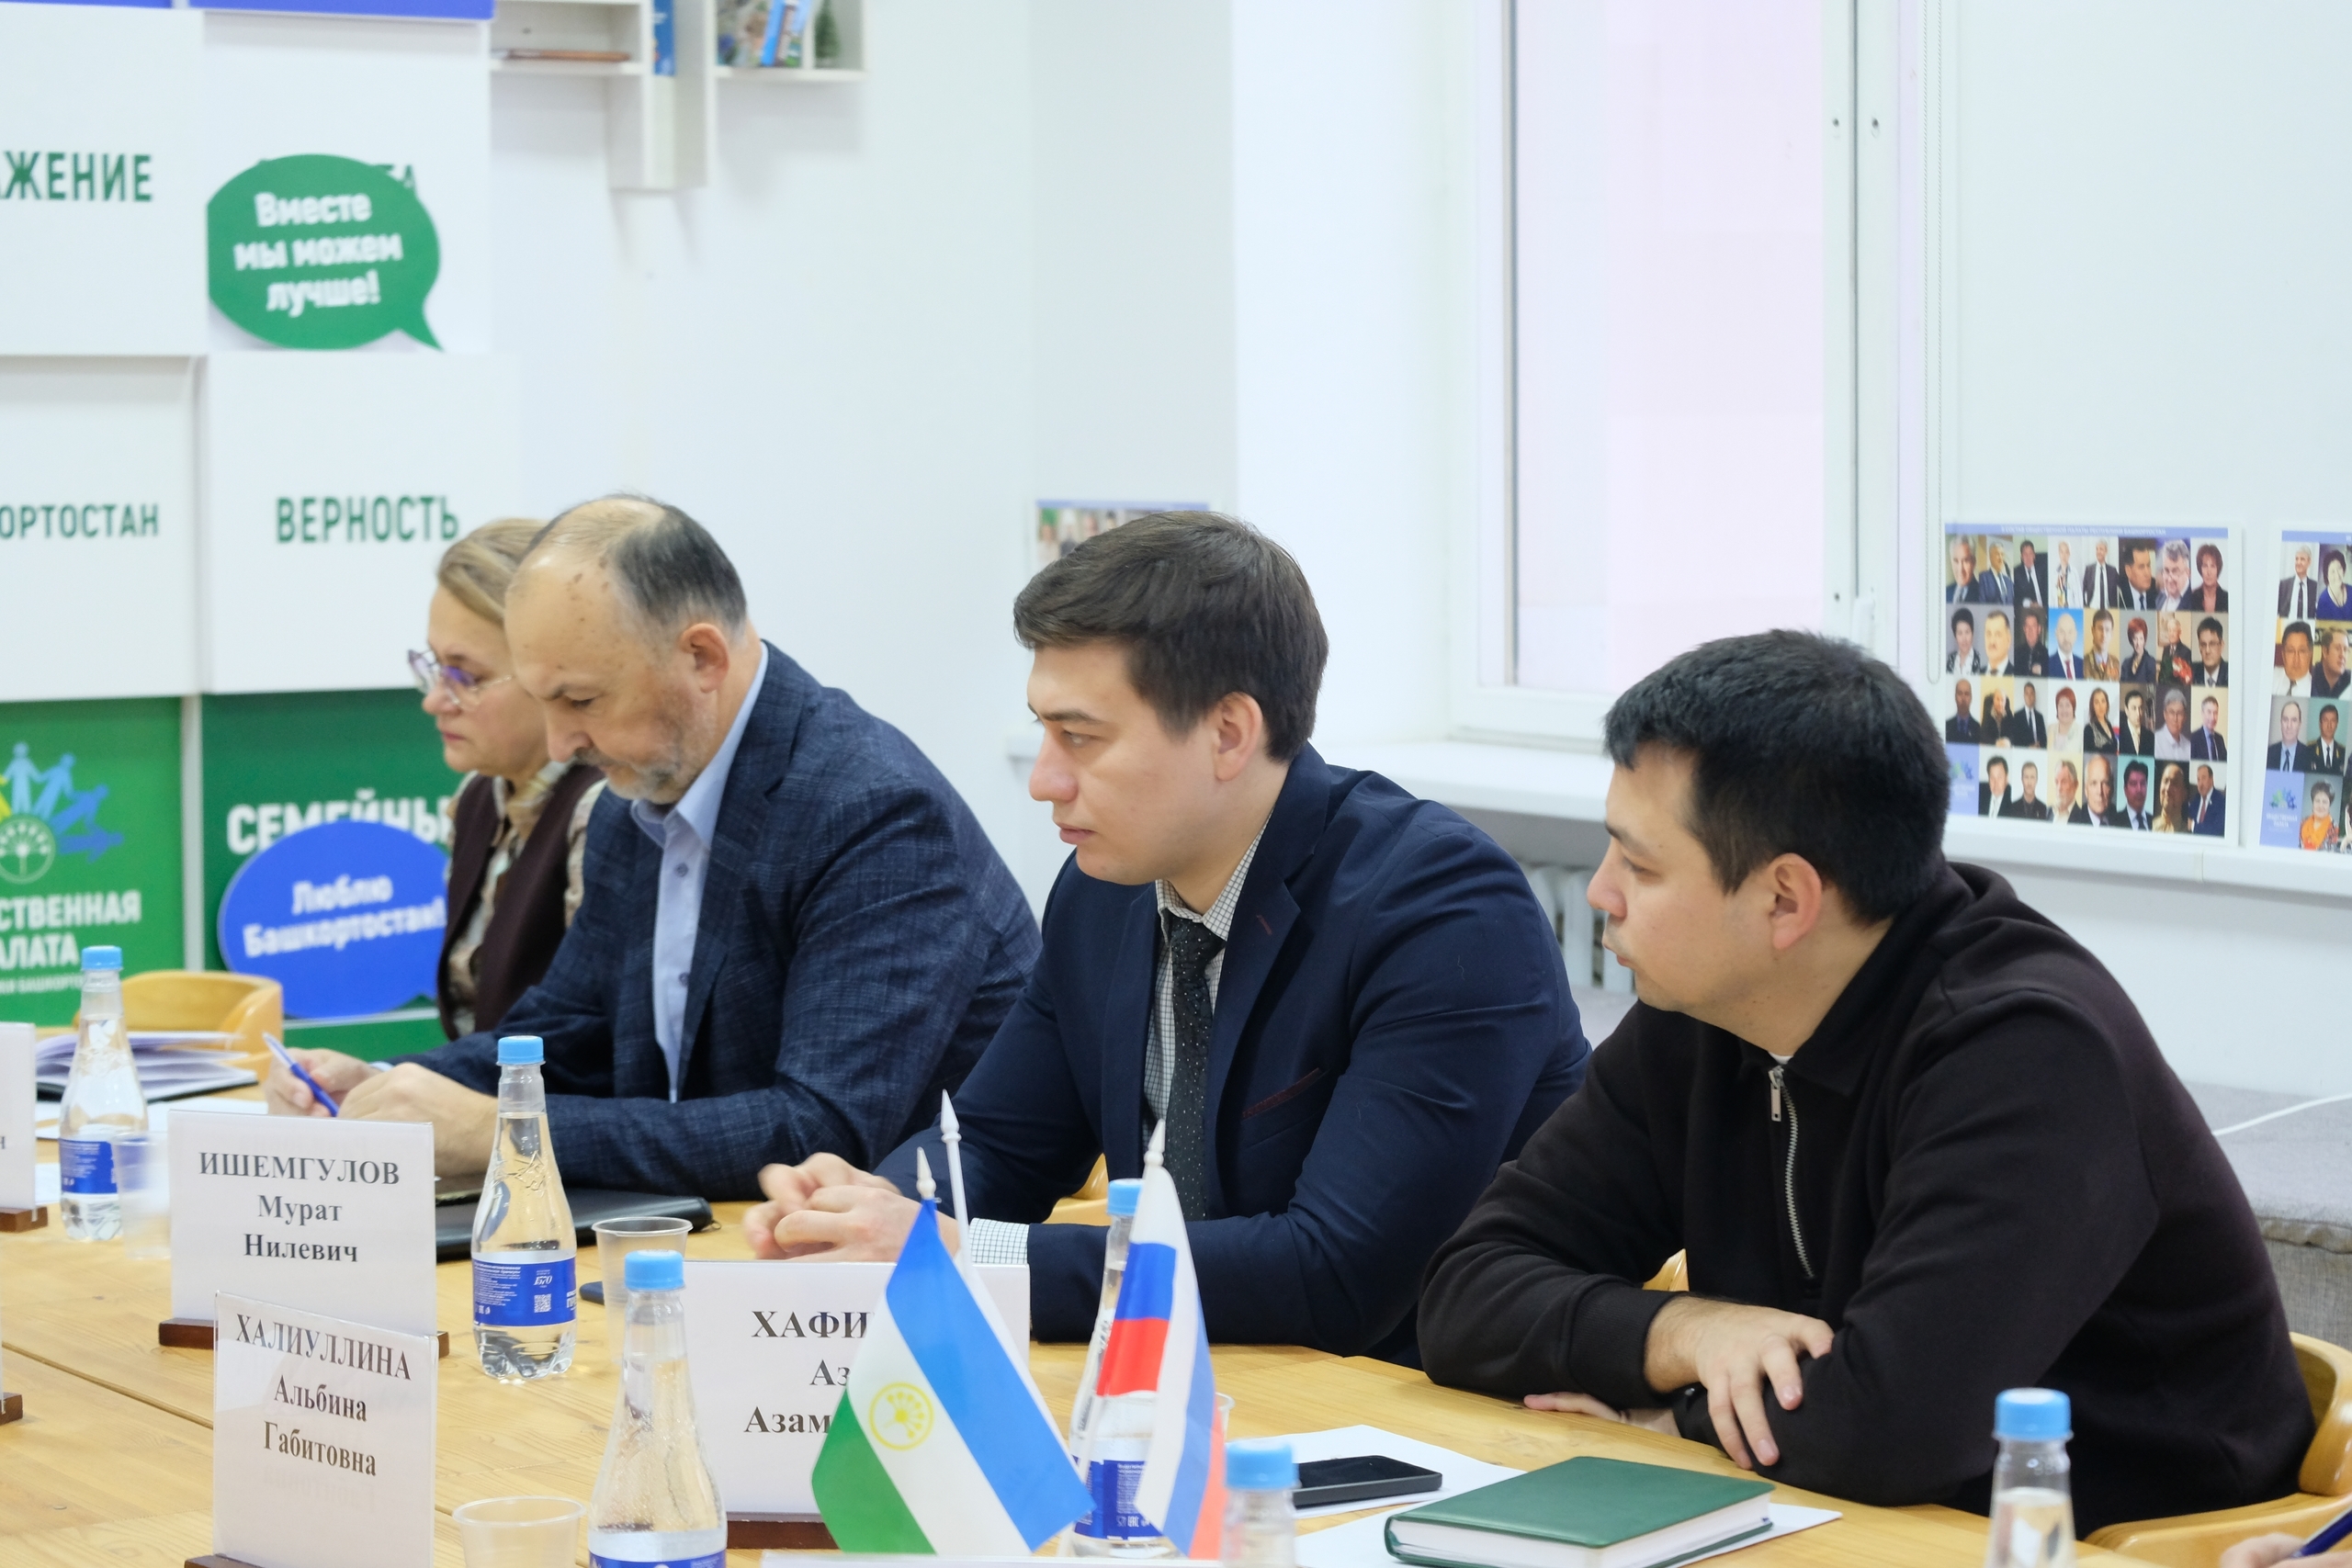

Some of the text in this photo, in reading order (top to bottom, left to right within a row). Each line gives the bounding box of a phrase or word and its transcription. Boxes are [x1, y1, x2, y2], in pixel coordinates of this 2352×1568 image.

[0, 151, 152, 202] ЖЕНИЕ
[254, 191, 372, 227] Вместе
[233, 232, 403, 271] мы можем
[266, 268, 381, 318] лучше!
[0, 503, 159, 539] ОРТОСТАН
[277, 495, 459, 544] ВЕРНОСТЬ
[291, 874, 393, 916] Люблю
[243, 897, 447, 958] Башкортостан!
[198, 1152, 400, 1185] ИШЕМГУЛОВ
[257, 1194, 343, 1226] Мурат
[243, 1233, 358, 1263] Нилевич
[752, 1310, 875, 1339] ХАФИ
[236, 1313, 412, 1381] ХАЛИУЛЛИНА
[274, 1374, 368, 1422] Альбина
[743, 1405, 831, 1434] Азам
[263, 1420, 377, 1477] Габитовна
